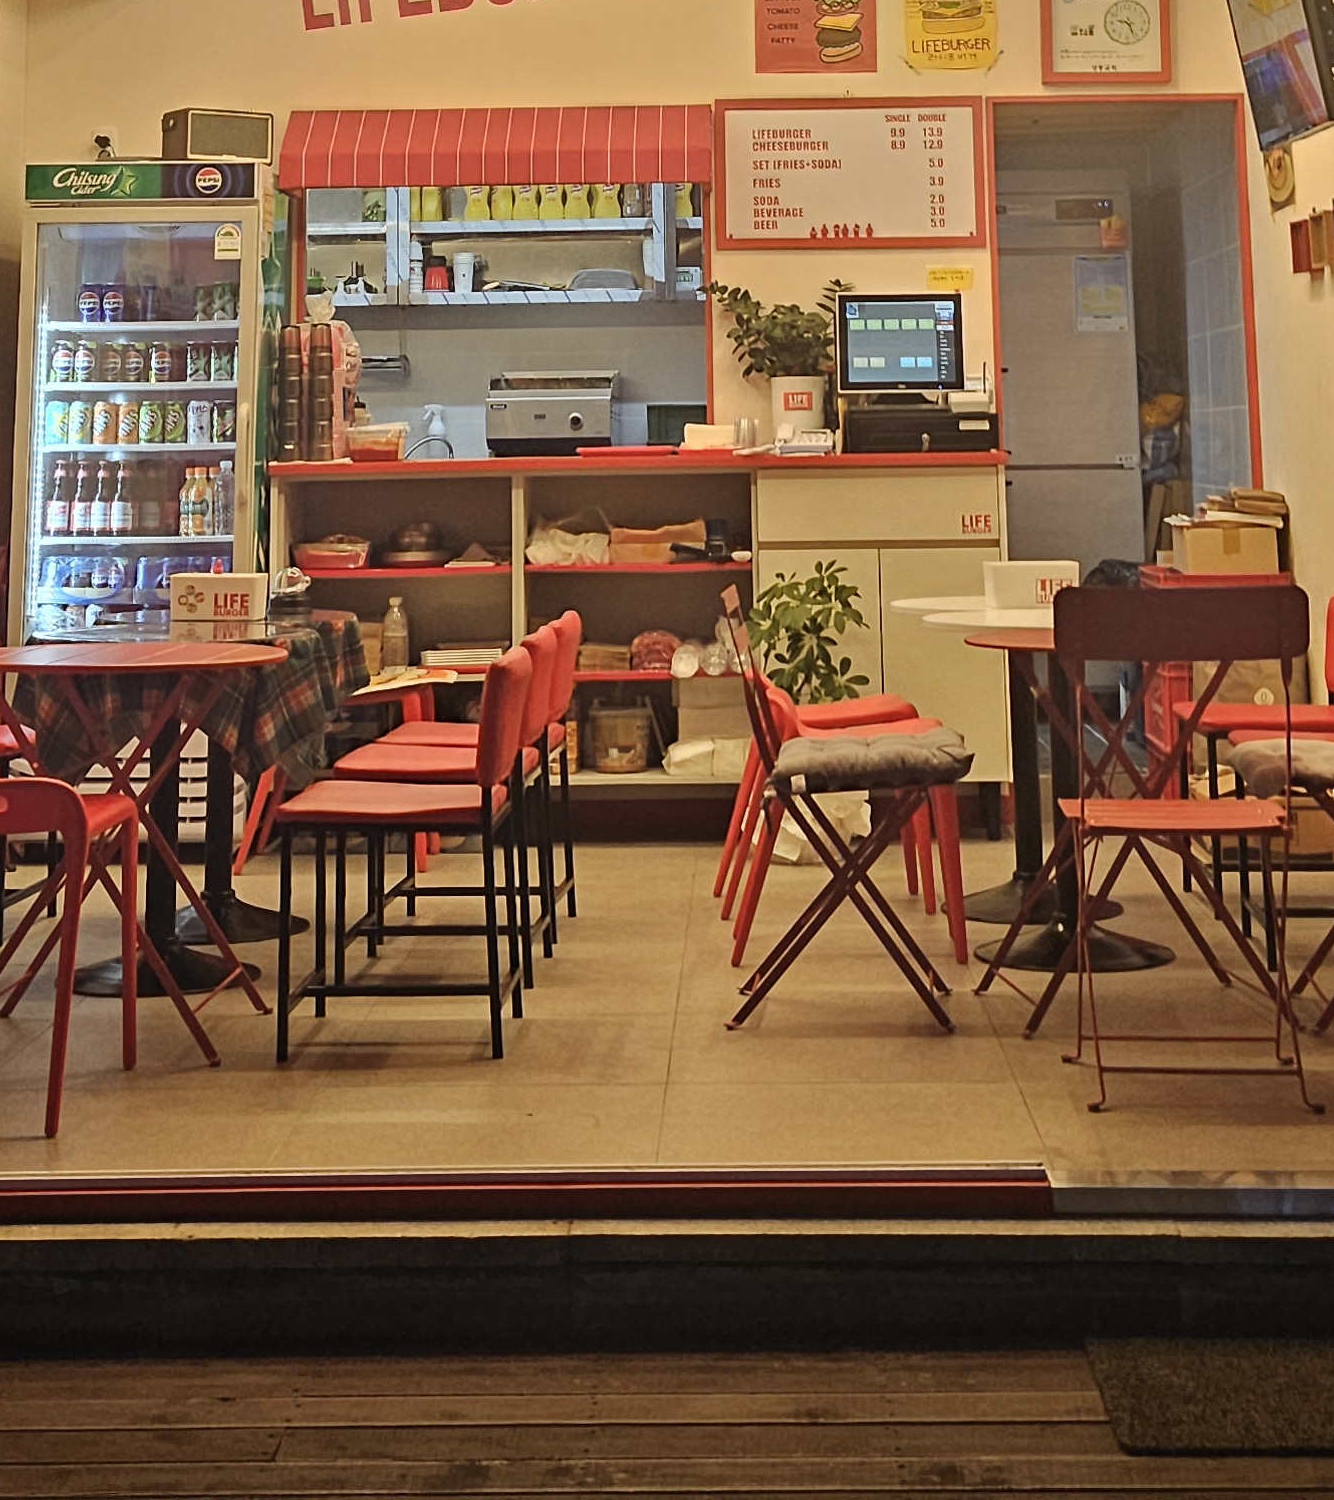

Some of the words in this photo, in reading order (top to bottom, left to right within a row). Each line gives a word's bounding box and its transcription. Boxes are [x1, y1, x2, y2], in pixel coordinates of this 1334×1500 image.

[912, 38, 991, 53] LIFEBURGER
[885, 114, 910, 122] SINGLE
[918, 114, 946, 122] DOUBLE
[752, 129, 811, 139] LIFEBURGER
[890, 128, 905, 138] 9.9
[922, 127, 943, 137] 13.9
[752, 141, 829, 152] CHEESEBURGER
[890, 140, 905, 150] 8.9
[923, 139, 943, 149] 12.9
[752, 160, 769, 170] SET
[929, 158, 943, 168] 5.0
[752, 178, 781, 188] FRIES
[929, 176, 944, 187] 3.9
[70, 185, 101, 195] Cider
[753, 196, 780, 206] SODA
[930, 194, 945, 204] 2.0
[753, 207, 804, 218] BEVERAGE
[930, 206, 945, 217] 3.0
[754, 220, 778, 230] BEER
[931, 219, 945, 229] 5.0
[962, 515, 991, 528] LIFE
[214, 593, 249, 609] LIFE
